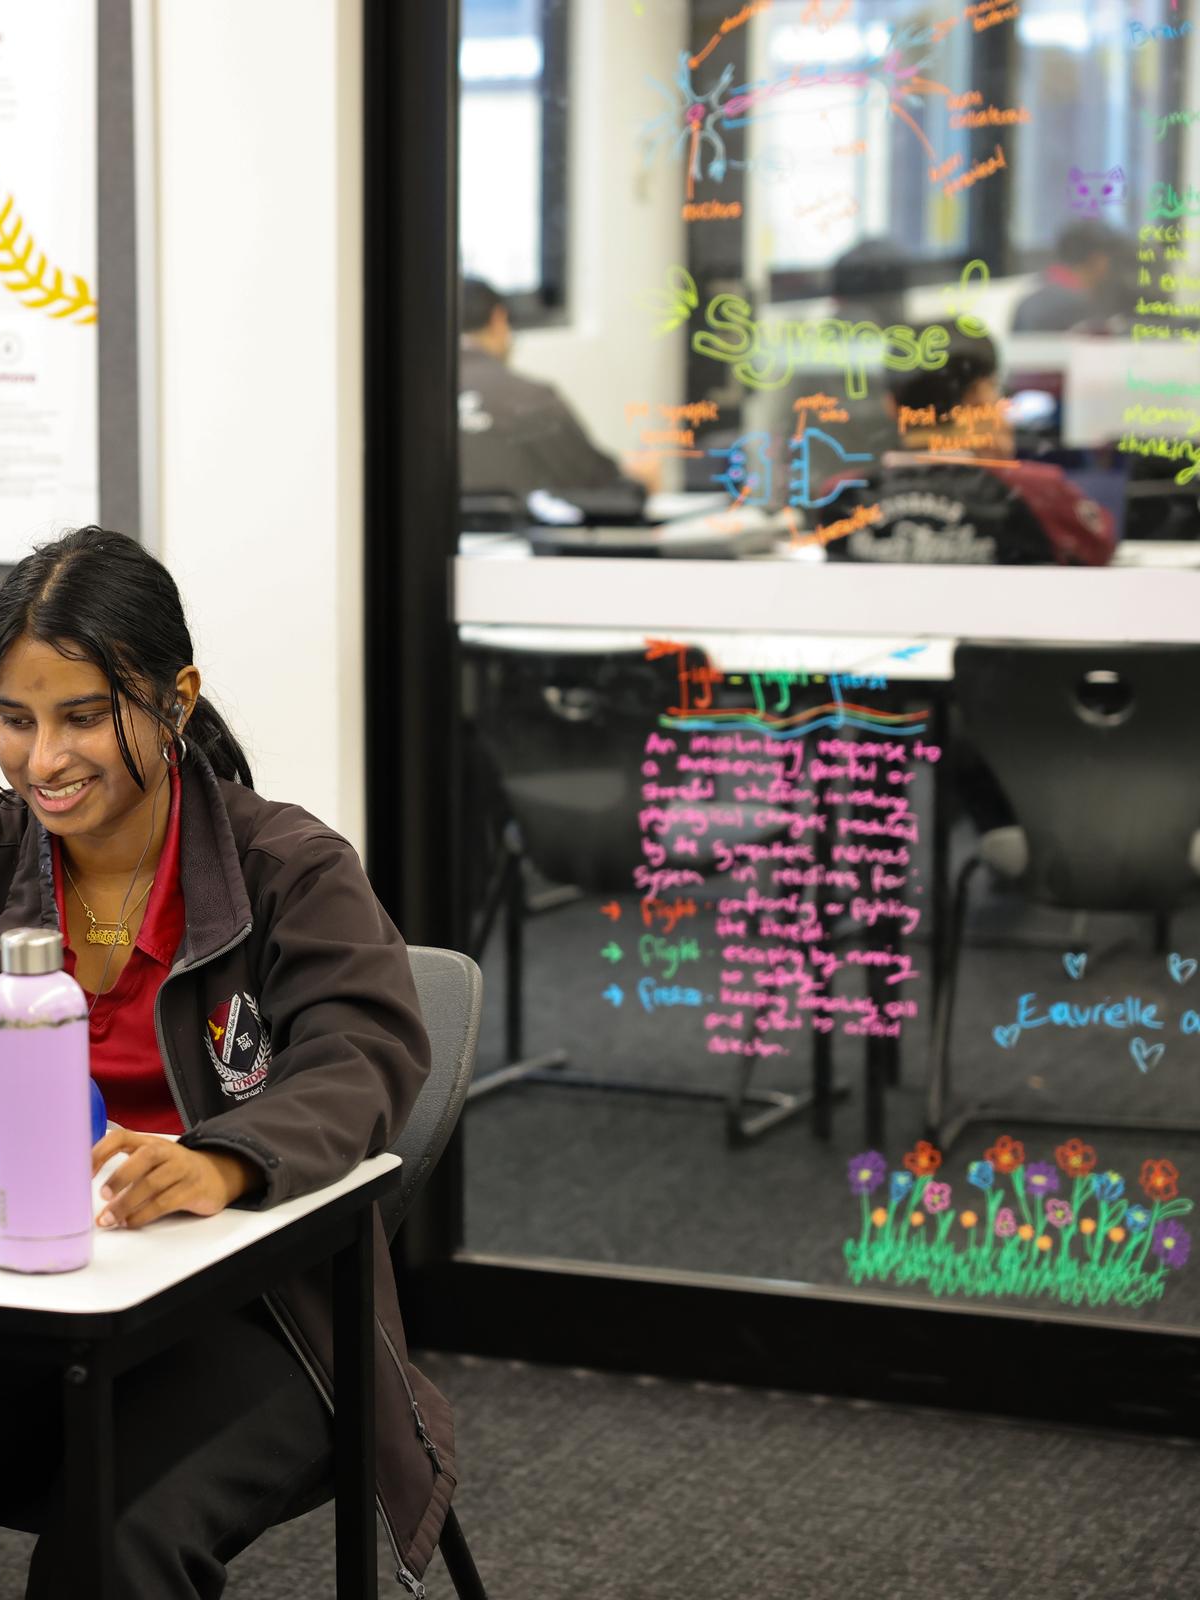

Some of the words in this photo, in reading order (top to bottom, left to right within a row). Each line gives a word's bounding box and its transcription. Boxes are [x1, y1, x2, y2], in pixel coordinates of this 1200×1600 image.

[693, 293, 951, 399] Synapse
[644, 732, 677, 756] An
[912, 740, 943, 763] to
[886, 769, 917, 785] or
[641, 837, 667, 867] by
[236, 1032, 249, 1046] EST
[234, 1085, 263, 1101] Secondary
